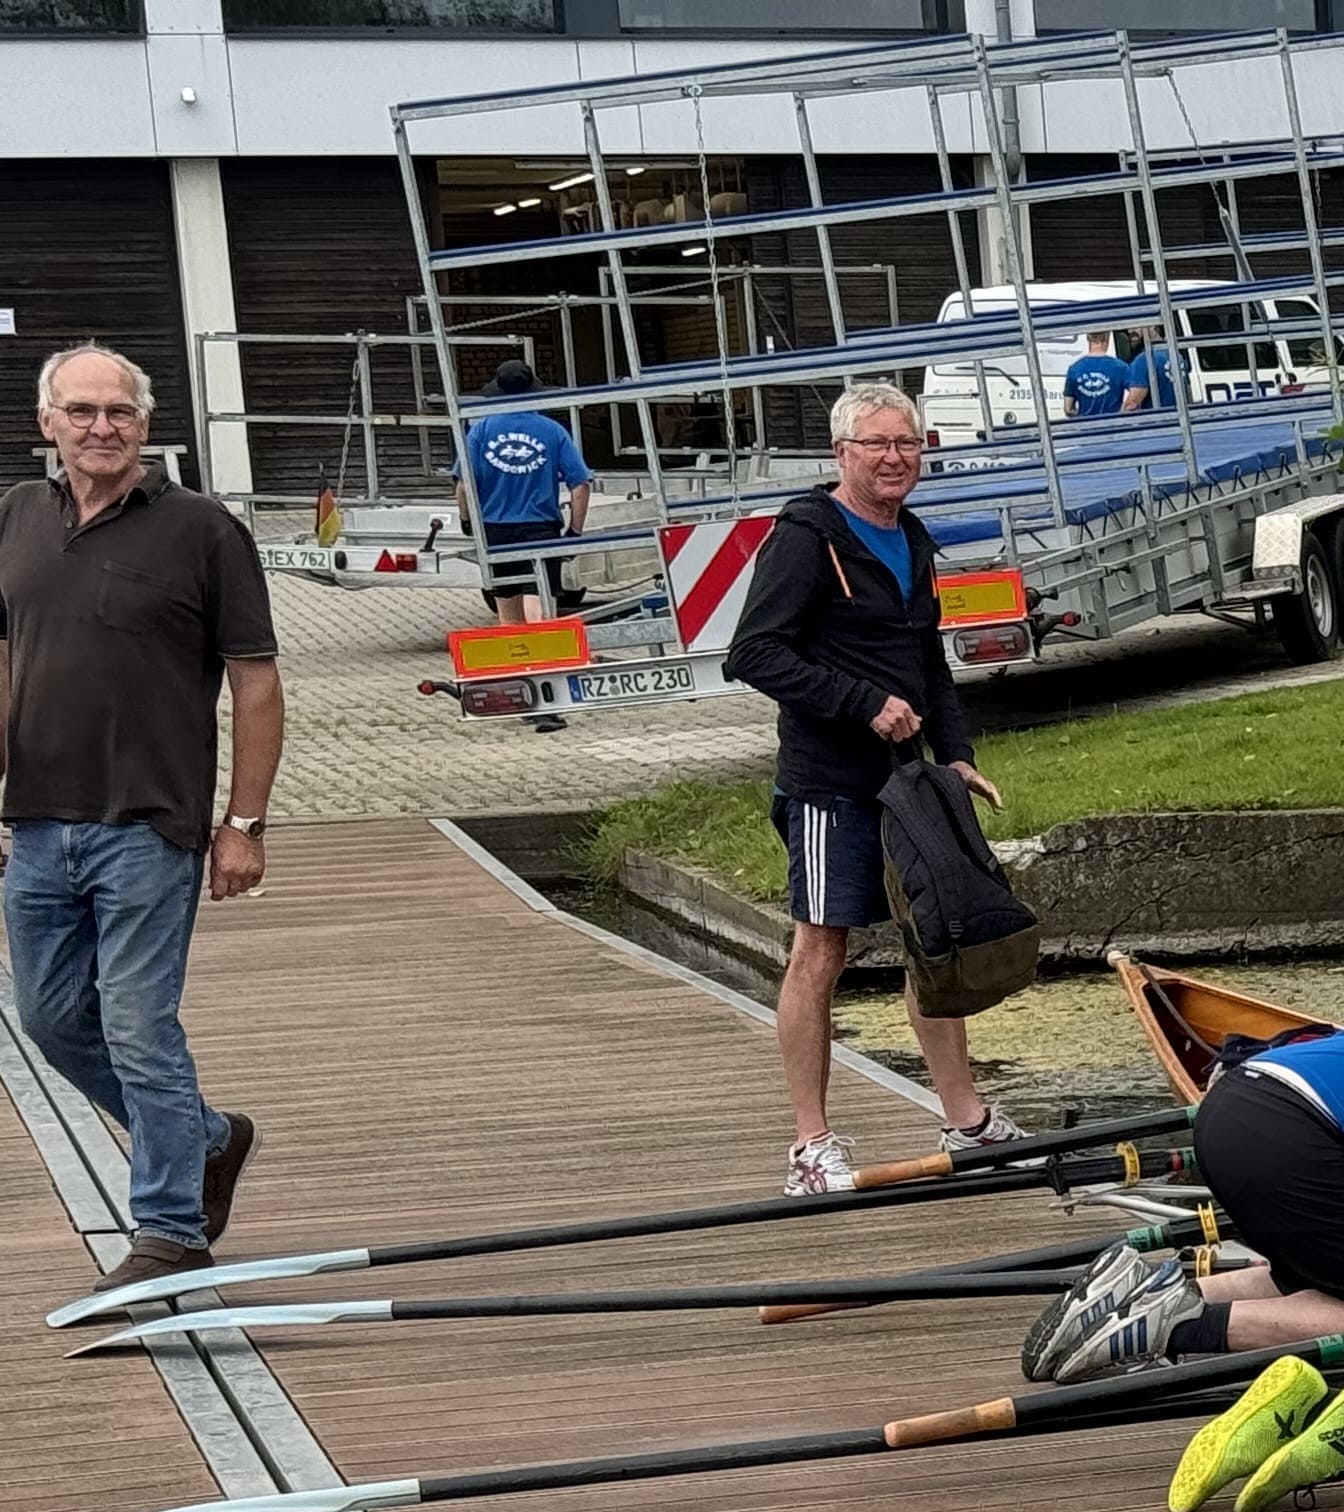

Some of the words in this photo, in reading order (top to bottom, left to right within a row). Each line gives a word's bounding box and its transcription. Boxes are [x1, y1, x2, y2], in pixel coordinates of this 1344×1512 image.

[1009, 389, 1033, 401] 2135
[274, 551, 296, 567] EX
[300, 551, 326, 568] 762
[580, 677, 609, 698] RZ
[619, 672, 648, 694] RC
[650, 667, 691, 692] 230
